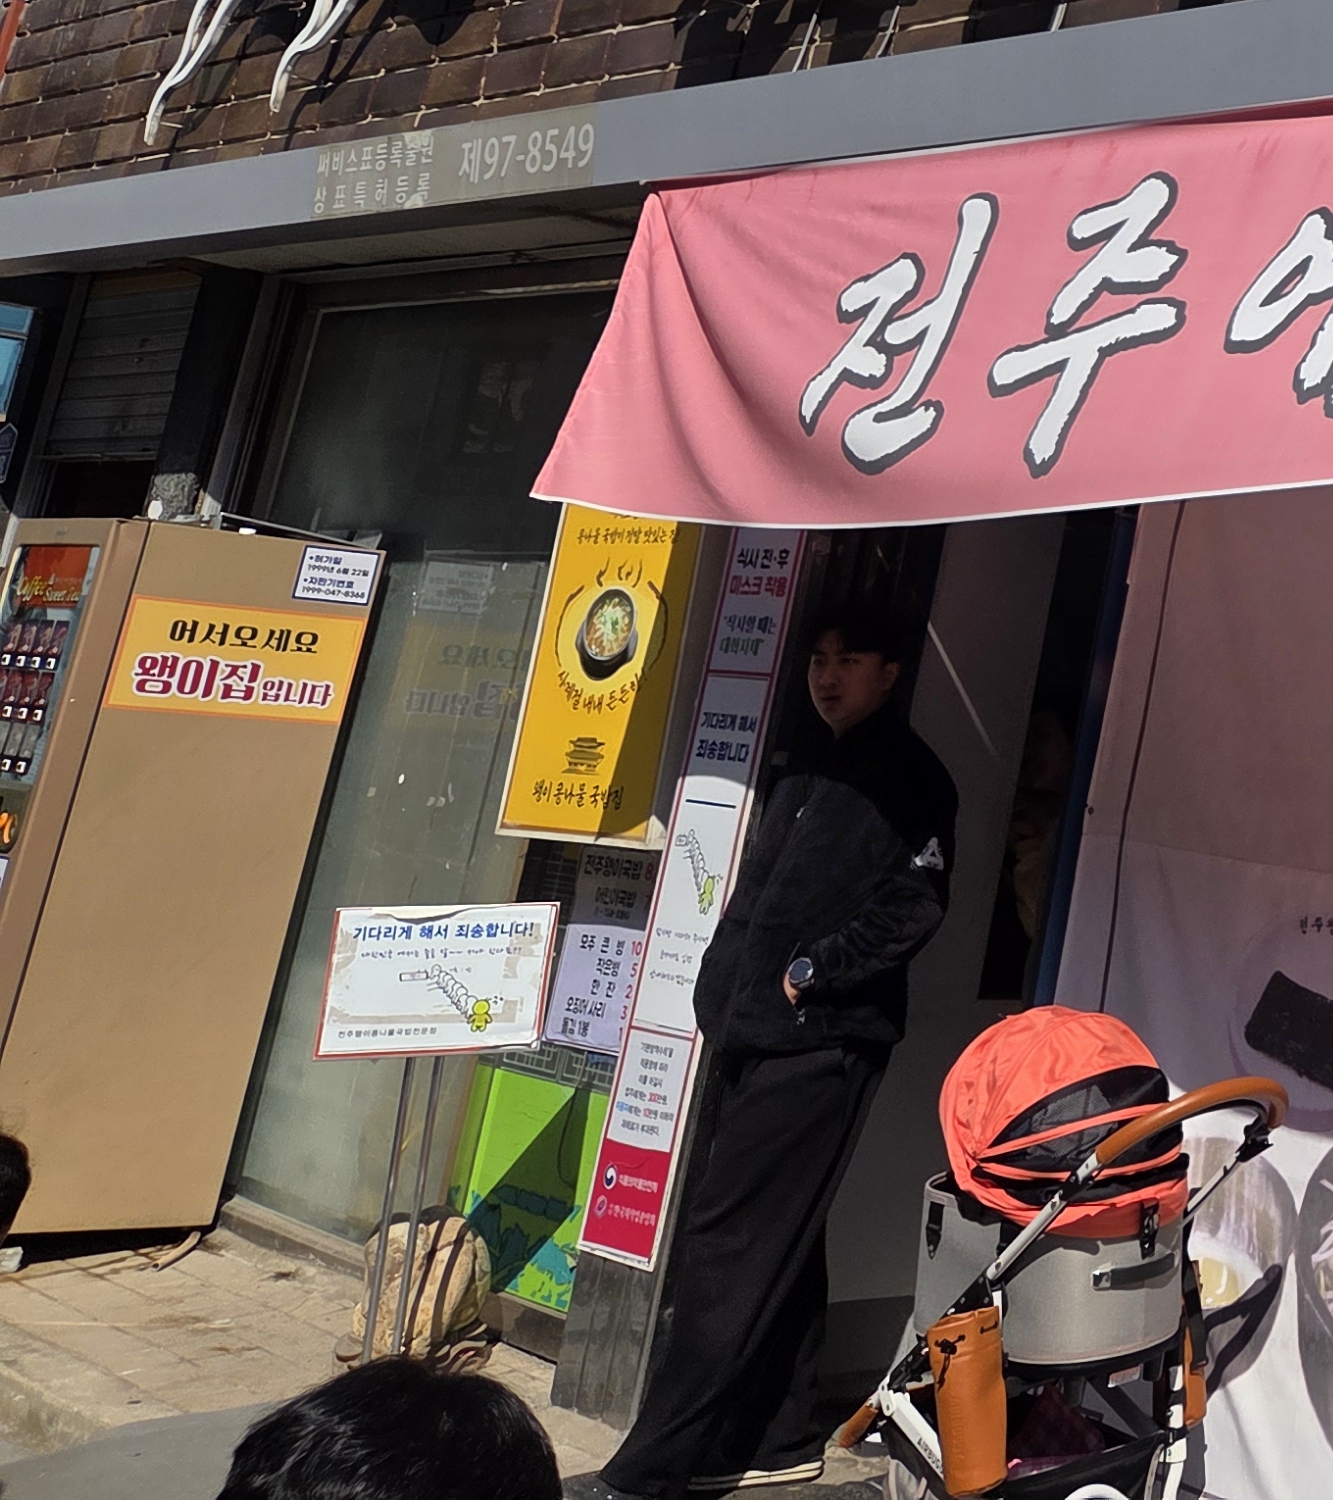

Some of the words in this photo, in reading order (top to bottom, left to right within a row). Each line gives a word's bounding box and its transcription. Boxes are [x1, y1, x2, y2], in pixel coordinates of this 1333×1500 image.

[458, 123, 595, 184] 제97-8549
[737, 547, 759, 569] 식사
[729, 575, 762, 596] 마스크
[168, 619, 319, 654] 어서오세요
[701, 711, 738, 731] 기다리게
[738, 714, 759, 734] 해서
[696, 739, 750, 763] 죄송합니다
[352, 925, 412, 941] 기다리게
[419, 924, 449, 940] 해서
[455, 921, 535, 939] 죄송합니다!
[580, 934, 597, 952] 모주
[600, 937, 610, 955] 큰
[596, 957, 621, 978] 작은병
